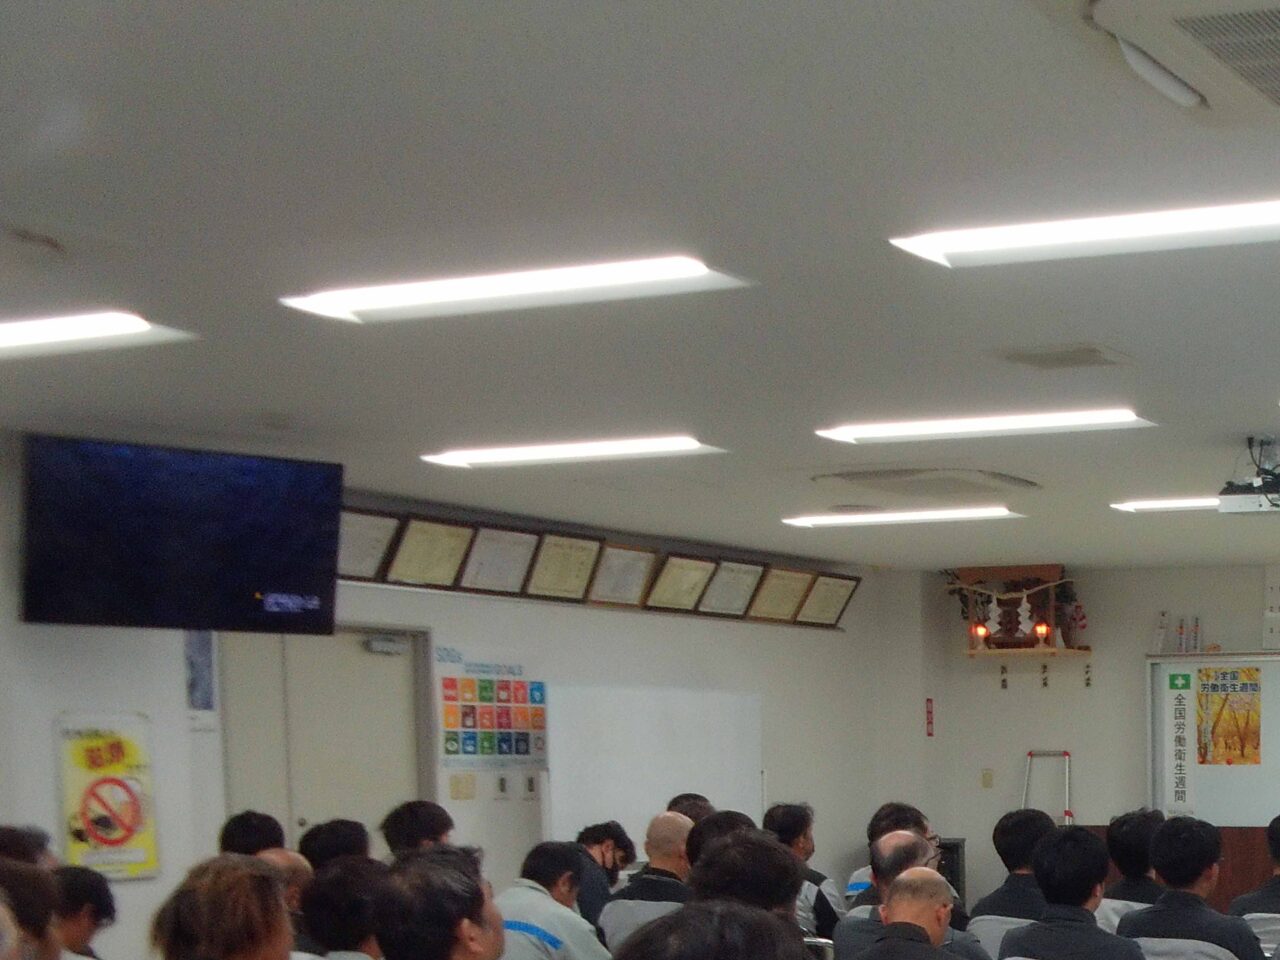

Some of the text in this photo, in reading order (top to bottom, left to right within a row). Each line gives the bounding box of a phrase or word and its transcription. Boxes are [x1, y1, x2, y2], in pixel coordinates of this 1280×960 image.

[1173, 693, 1187, 803] 全国労働衛生週間
